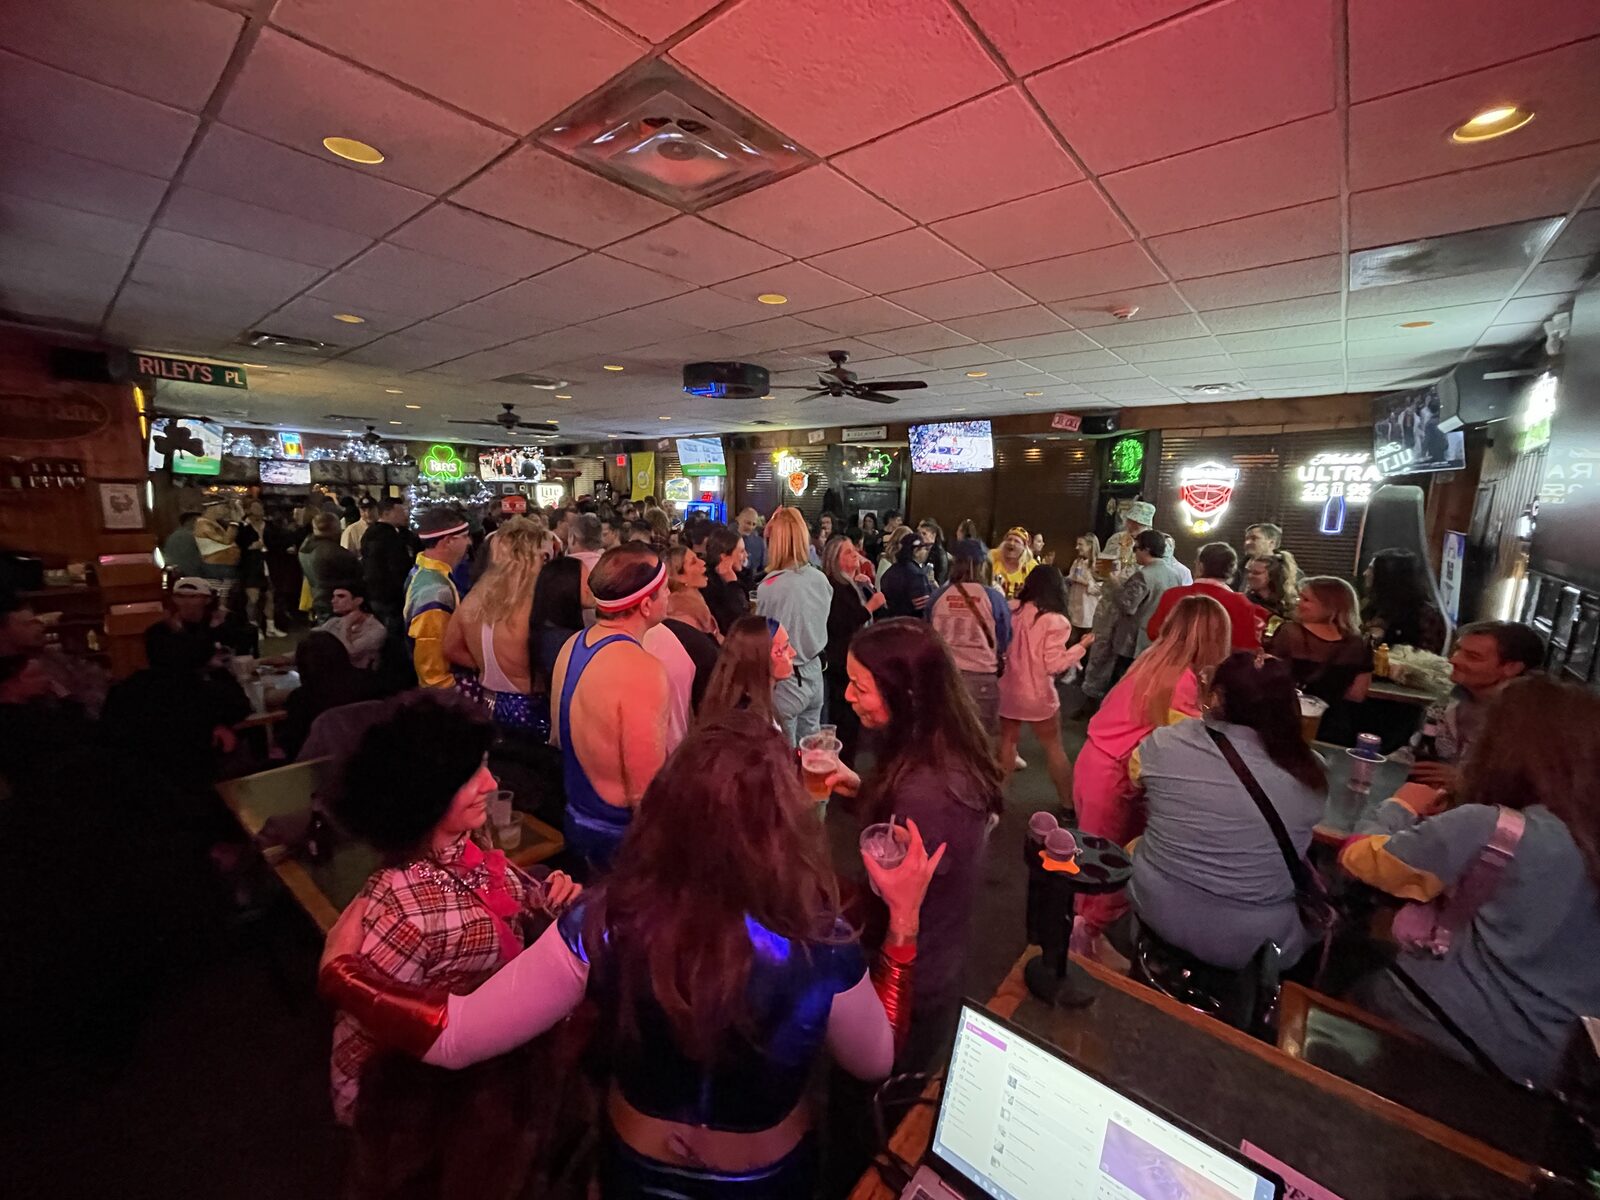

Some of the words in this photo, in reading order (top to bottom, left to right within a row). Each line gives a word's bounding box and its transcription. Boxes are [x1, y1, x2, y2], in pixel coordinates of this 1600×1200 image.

[138, 357, 213, 382] RILEY'S
[224, 370, 244, 385] PL
[1298, 466, 1384, 482] ULTRA
